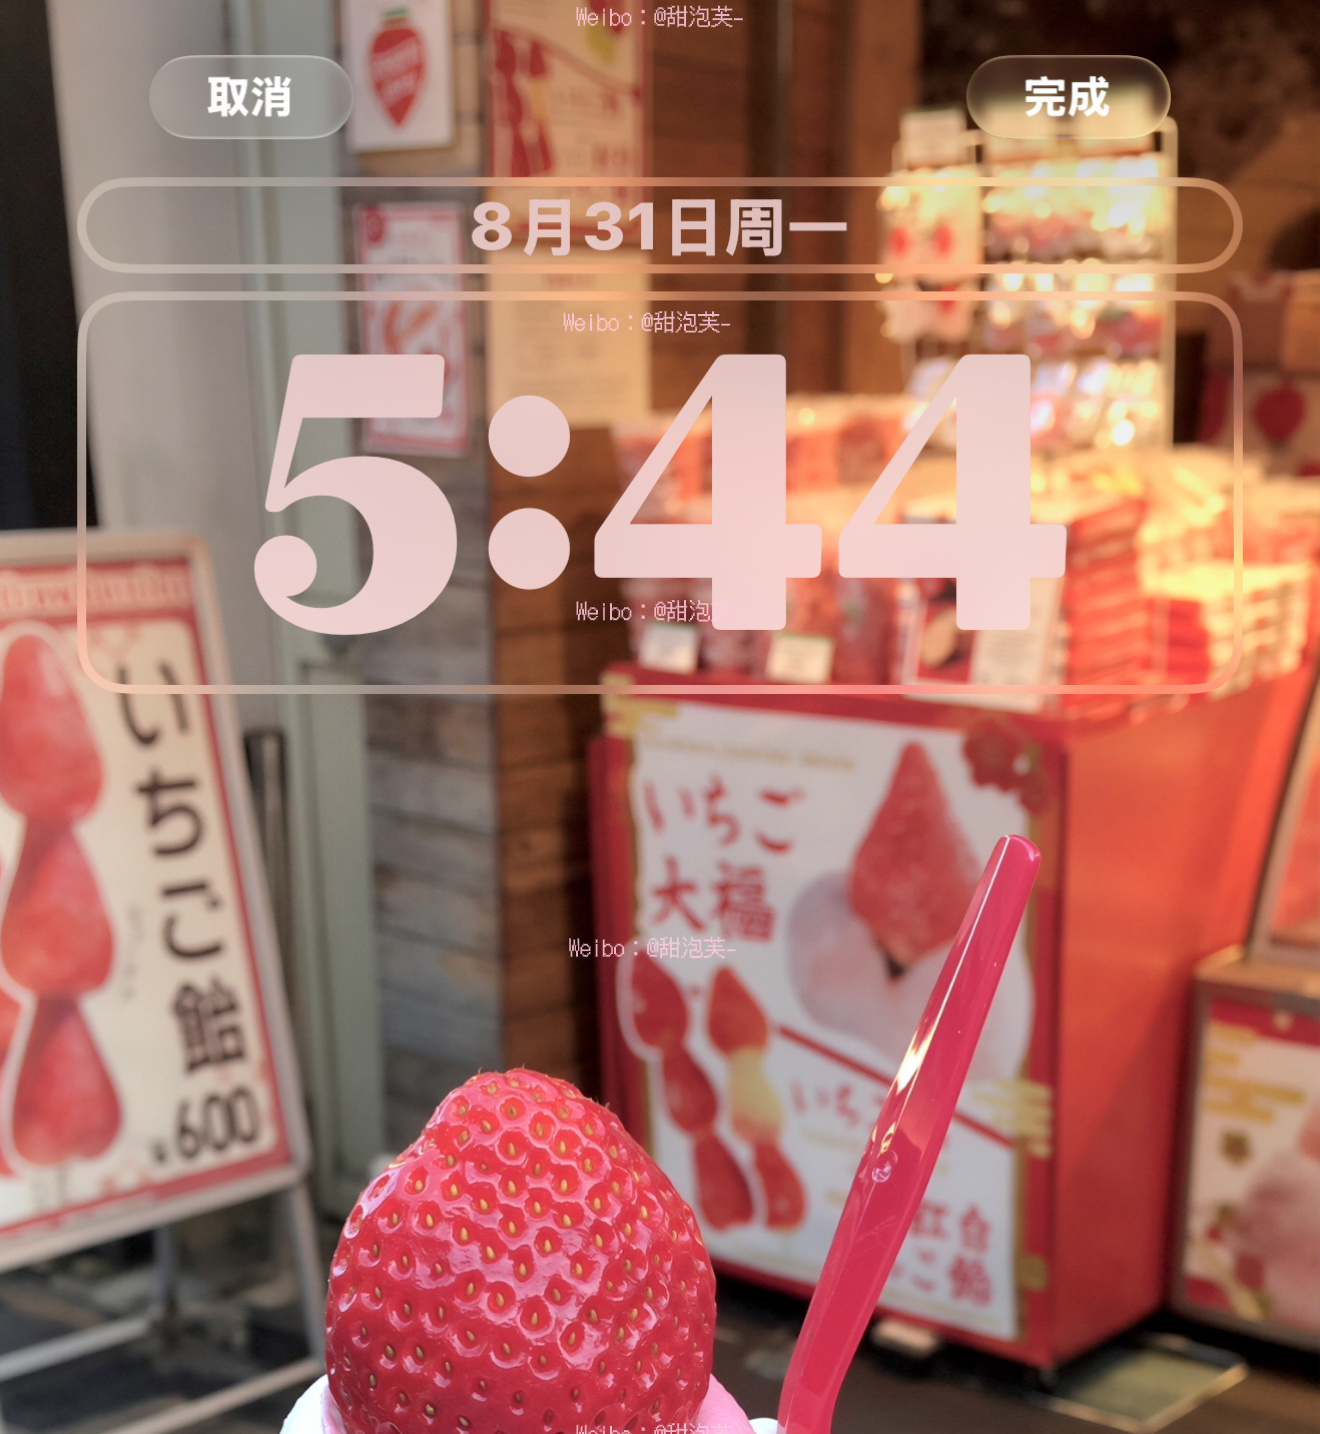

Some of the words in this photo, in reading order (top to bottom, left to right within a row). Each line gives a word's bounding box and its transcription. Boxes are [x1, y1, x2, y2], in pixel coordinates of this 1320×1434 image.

[643, 773, 806, 855] いちご
[115, 660, 248, 1076] いちご飴
[652, 854, 776, 944] 大福
